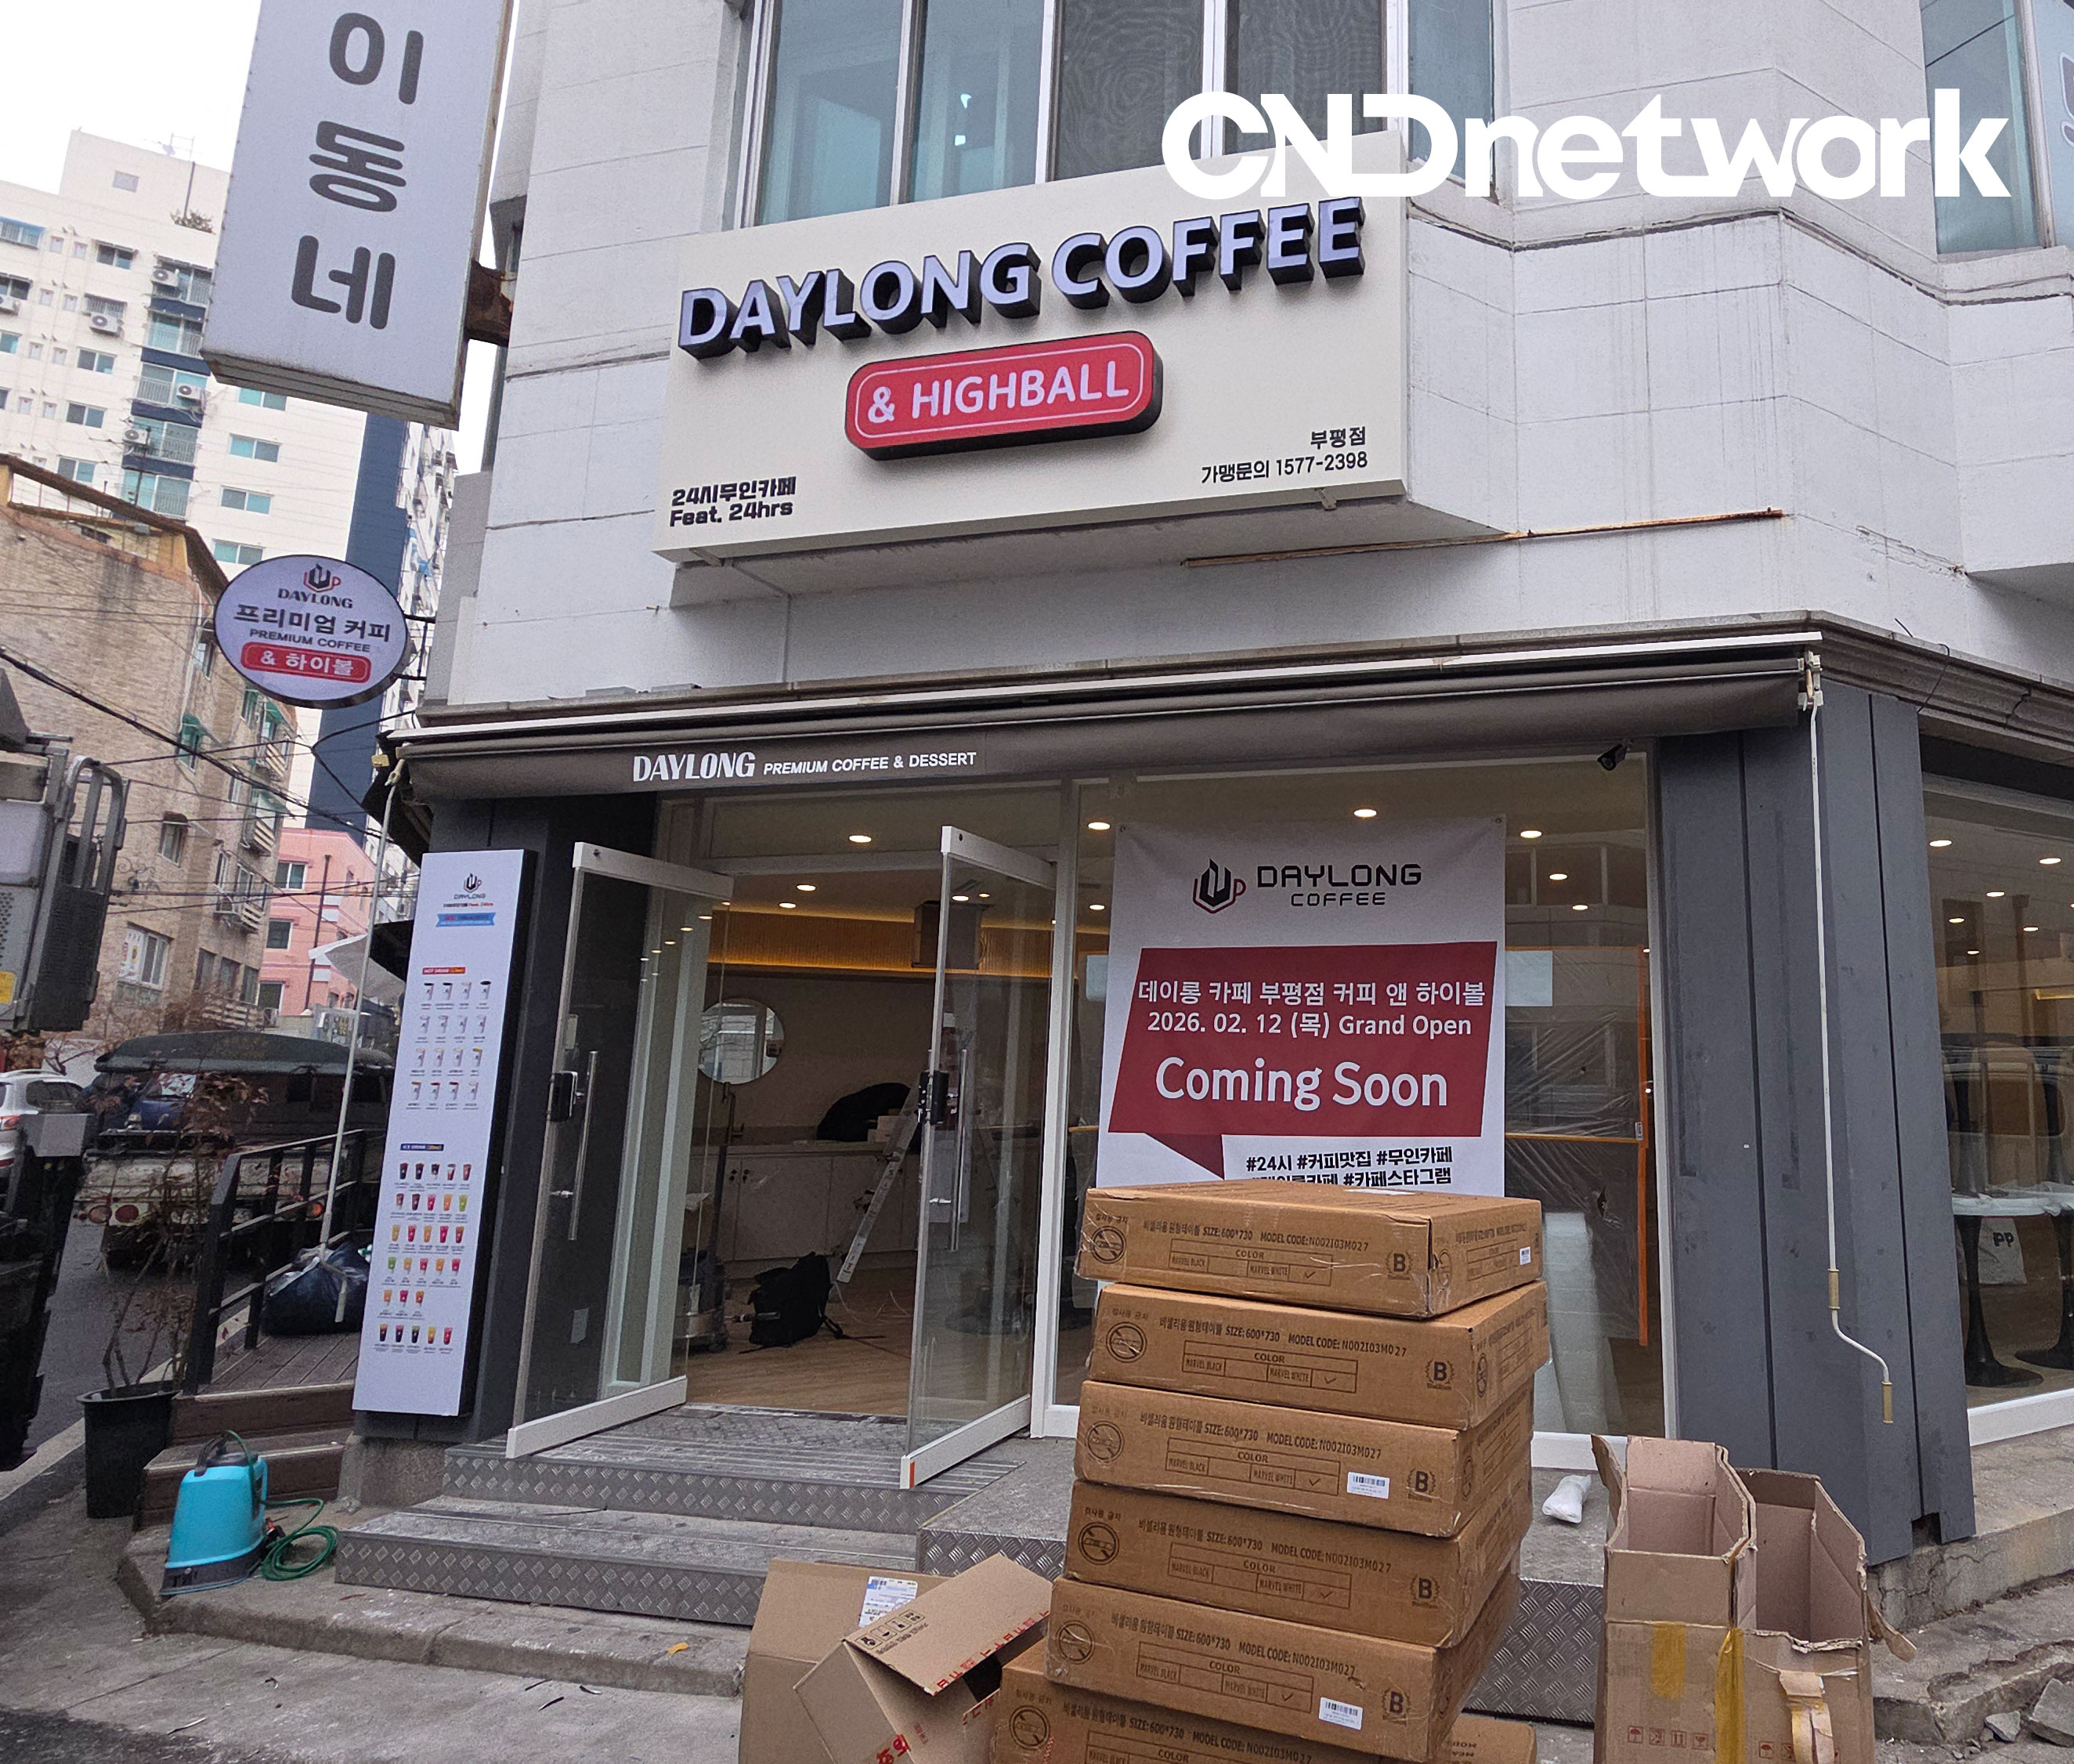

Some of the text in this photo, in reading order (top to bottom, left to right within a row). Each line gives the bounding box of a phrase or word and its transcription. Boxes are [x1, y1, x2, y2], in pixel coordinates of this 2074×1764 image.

[291, 13, 424, 331] 이동네
[678, 197, 1364, 357] DAYLONG COFFEE
[868, 361, 1129, 424] & HIGHBALL
[1310, 426, 1365, 450] 부평점
[1201, 451, 1368, 483] 가맹문의 1577-2398
[671, 476, 797, 507] 24시무인카페
[670, 501, 793, 527] Feat. 24hrs
[278, 588, 353, 609] DAYLONG
[233, 604, 391, 642] 프리미엄 커피
[249, 628, 370, 652] PREMIUM COFFEE
[260, 651, 354, 677] & 하이볼
[633, 752, 977, 782] DAYLONG PREMIUM COFFEE & DESSERT
[1257, 863, 1422, 887] DAYLONG
[1291, 892, 1386, 907] COFFEE
[1138, 980, 1486, 1007] 데이롱 카페 부평점 커피 앤 하이볼
[1147, 1012, 1472, 1039] 2026. 02. 12 (목) Grand Open
[1156, 1057, 1447, 1112] Coming Soon
[1246, 1145, 1453, 1172] #24시 #커피맛집 #무인카페
[1343, 1167, 1452, 1187] #카페스타그램
[1235, 1249, 1265, 1259] COLOR
[1394, 1254, 1406, 1272] B
[1288, 1333, 1314, 1346] MODEL
[1255, 1353, 1285, 1363] COLOR
[1433, 1361, 1447, 1381] B
[1266, 1432, 1292, 1447] MODEL
[1238, 1451, 1268, 1463] COLOR
[1415, 1471, 1429, 1492] B
[1271, 1542, 1298, 1558] MODEL
[1243, 1560, 1276, 1574] COLOR
[1418, 1578, 1433, 1599] B
[1238, 1641, 1265, 1658] MODEL
[1209, 1661, 1241, 1675] COLOR
[1389, 1690, 1404, 1715] B
